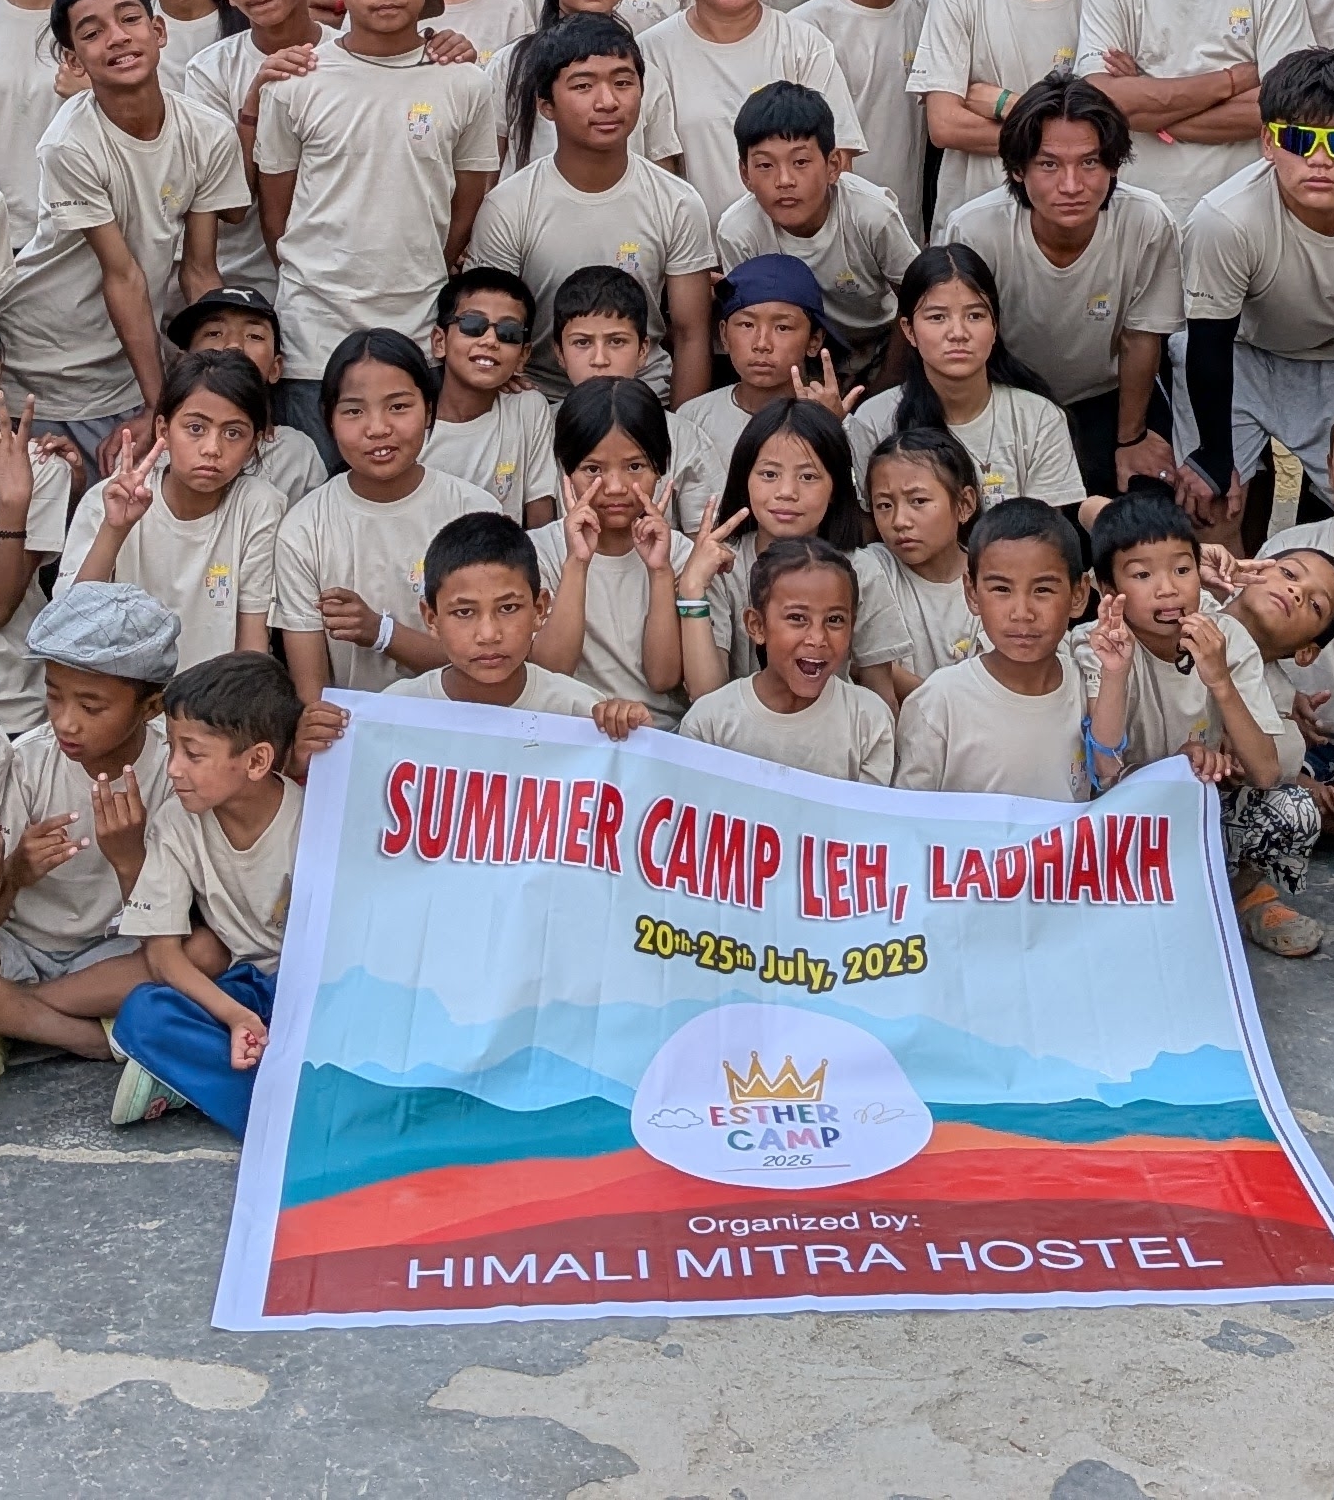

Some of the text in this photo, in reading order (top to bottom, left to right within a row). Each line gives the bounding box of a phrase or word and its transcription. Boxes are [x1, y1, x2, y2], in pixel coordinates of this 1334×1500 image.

[381, 758, 1175, 923] SUMMER CAMP LEH, LADHAKH
[636, 916, 927, 993] 20th-25th July, 2025
[709, 1104, 841, 1127] ESTHER
[727, 1126, 842, 1151] CAMP
[762, 1153, 814, 1168] 2025
[688, 1211, 922, 1237] Organized by:
[408, 1236, 1224, 1289] HIMALI MITRA HOSTEL
